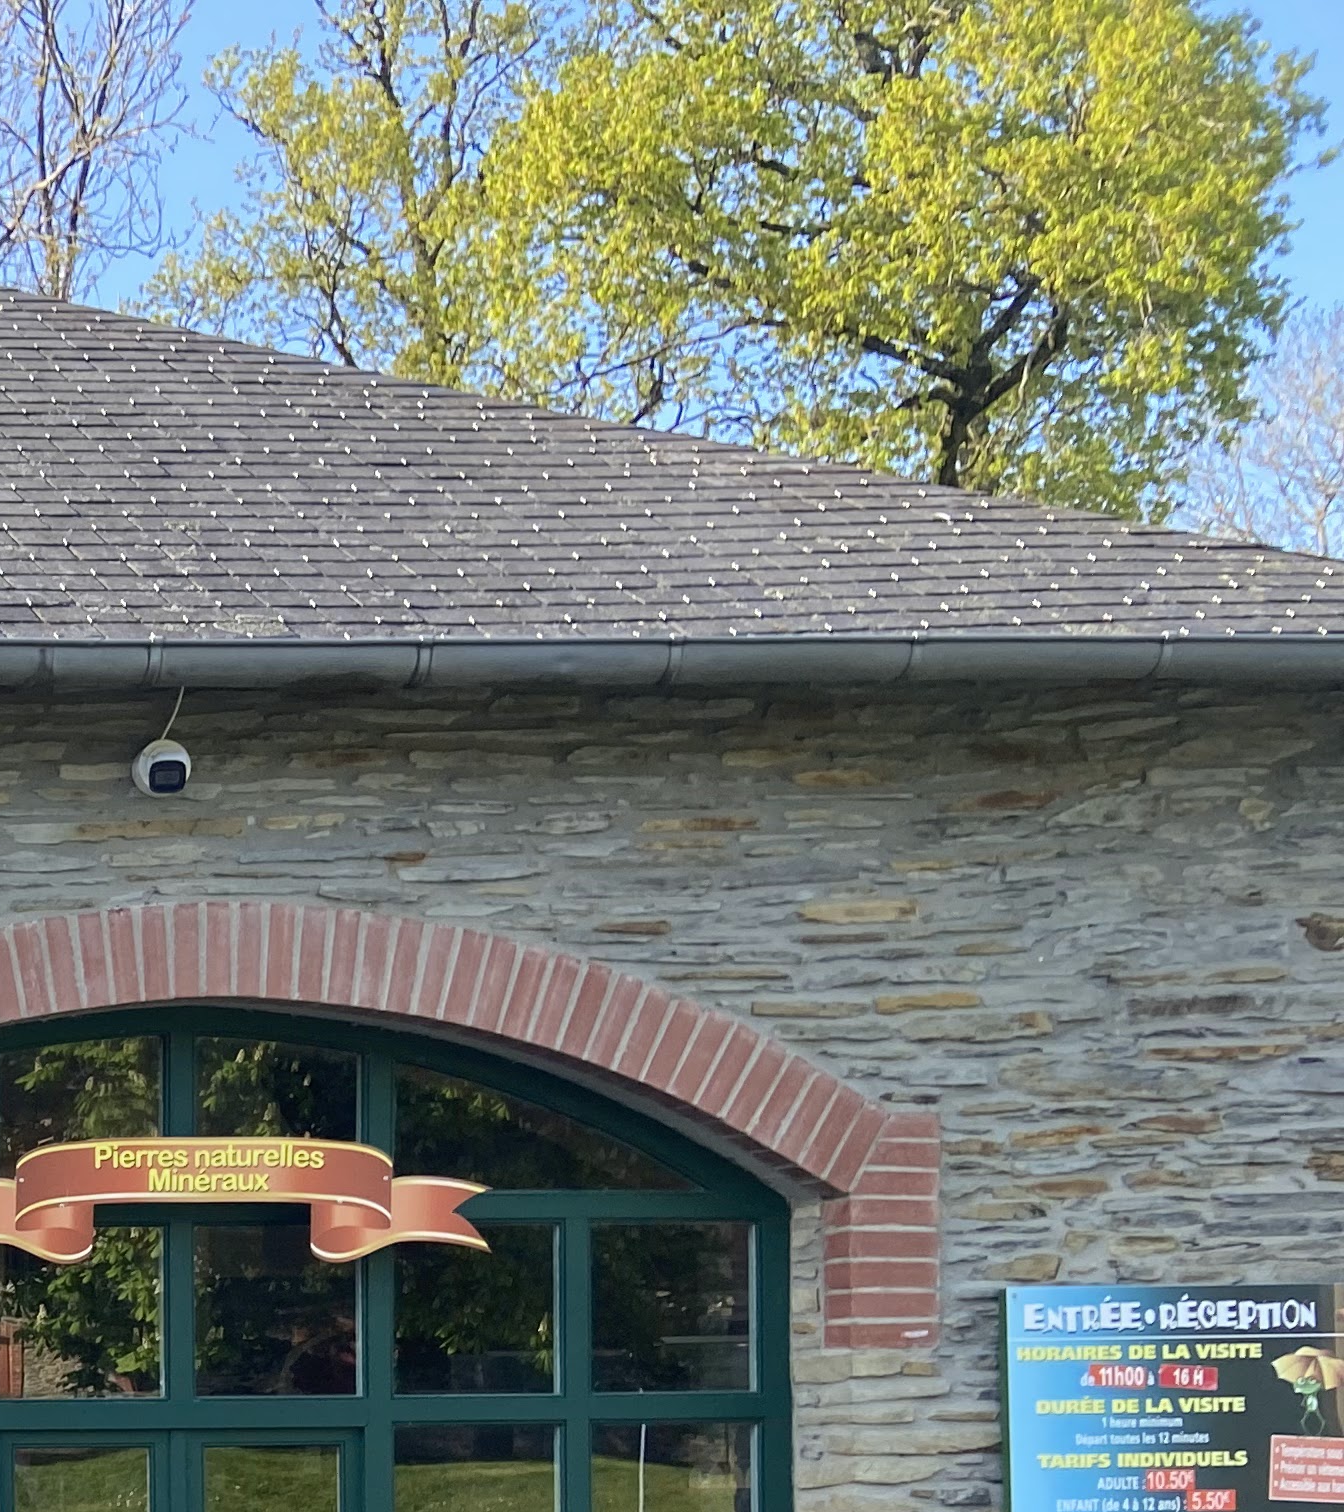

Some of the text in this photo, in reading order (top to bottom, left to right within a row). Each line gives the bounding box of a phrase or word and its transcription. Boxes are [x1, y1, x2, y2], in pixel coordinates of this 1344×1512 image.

[94, 1143, 326, 1170] Pierres naturelles
[148, 1168, 271, 1193] Minéraux
[1023, 1293, 1317, 1333] ENTRÉE RÉCEPTION
[1016, 1342, 1263, 1362] HORAIRES DE LA VISITE
[1098, 1366, 1145, 1387] 11h00
[1147, 1370, 1155, 1386] à
[1173, 1367, 1189, 1386] 16
[1193, 1367, 1204, 1386] H
[1035, 1396, 1246, 1415] DURÉE DE LA VISITE
[1158, 1431, 1170, 1444] 12
[1036, 1450, 1248, 1469] TARIFS INDIVIDUELS
[1097, 1475, 1140, 1490] ADULTE
[1056, 1499, 1099, 1512] ENFANT
[1101, 1497, 1120, 1512] (de
[1122, 1497, 1129, 1511] 4
[1132, 1496, 1138, 1511] à
[1141, 1497, 1155, 1511] 12
[1156, 1496, 1181, 1512] ans)
